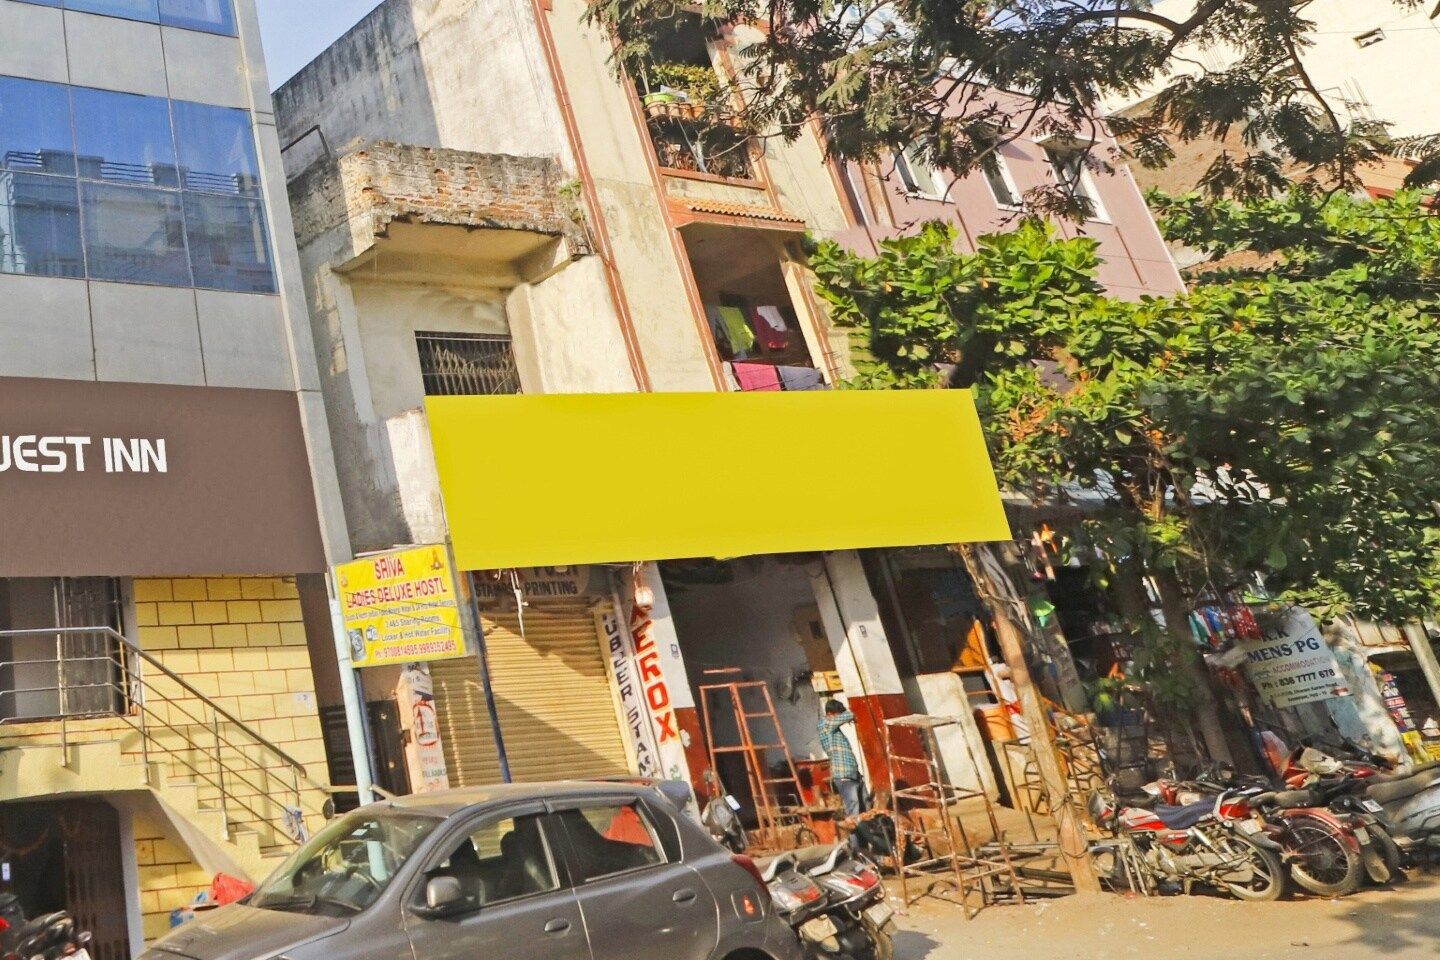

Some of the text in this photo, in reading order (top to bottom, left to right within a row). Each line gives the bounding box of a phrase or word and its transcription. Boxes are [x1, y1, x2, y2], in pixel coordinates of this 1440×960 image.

[103, 438, 168, 473] INN
[346, 577, 448, 609] LADIES DELUXE HOSTL
[523, 580, 578, 596] PRINTING
[1247, 637, 1320, 663] MENS PG
[1318, 668, 1336, 679] 678
